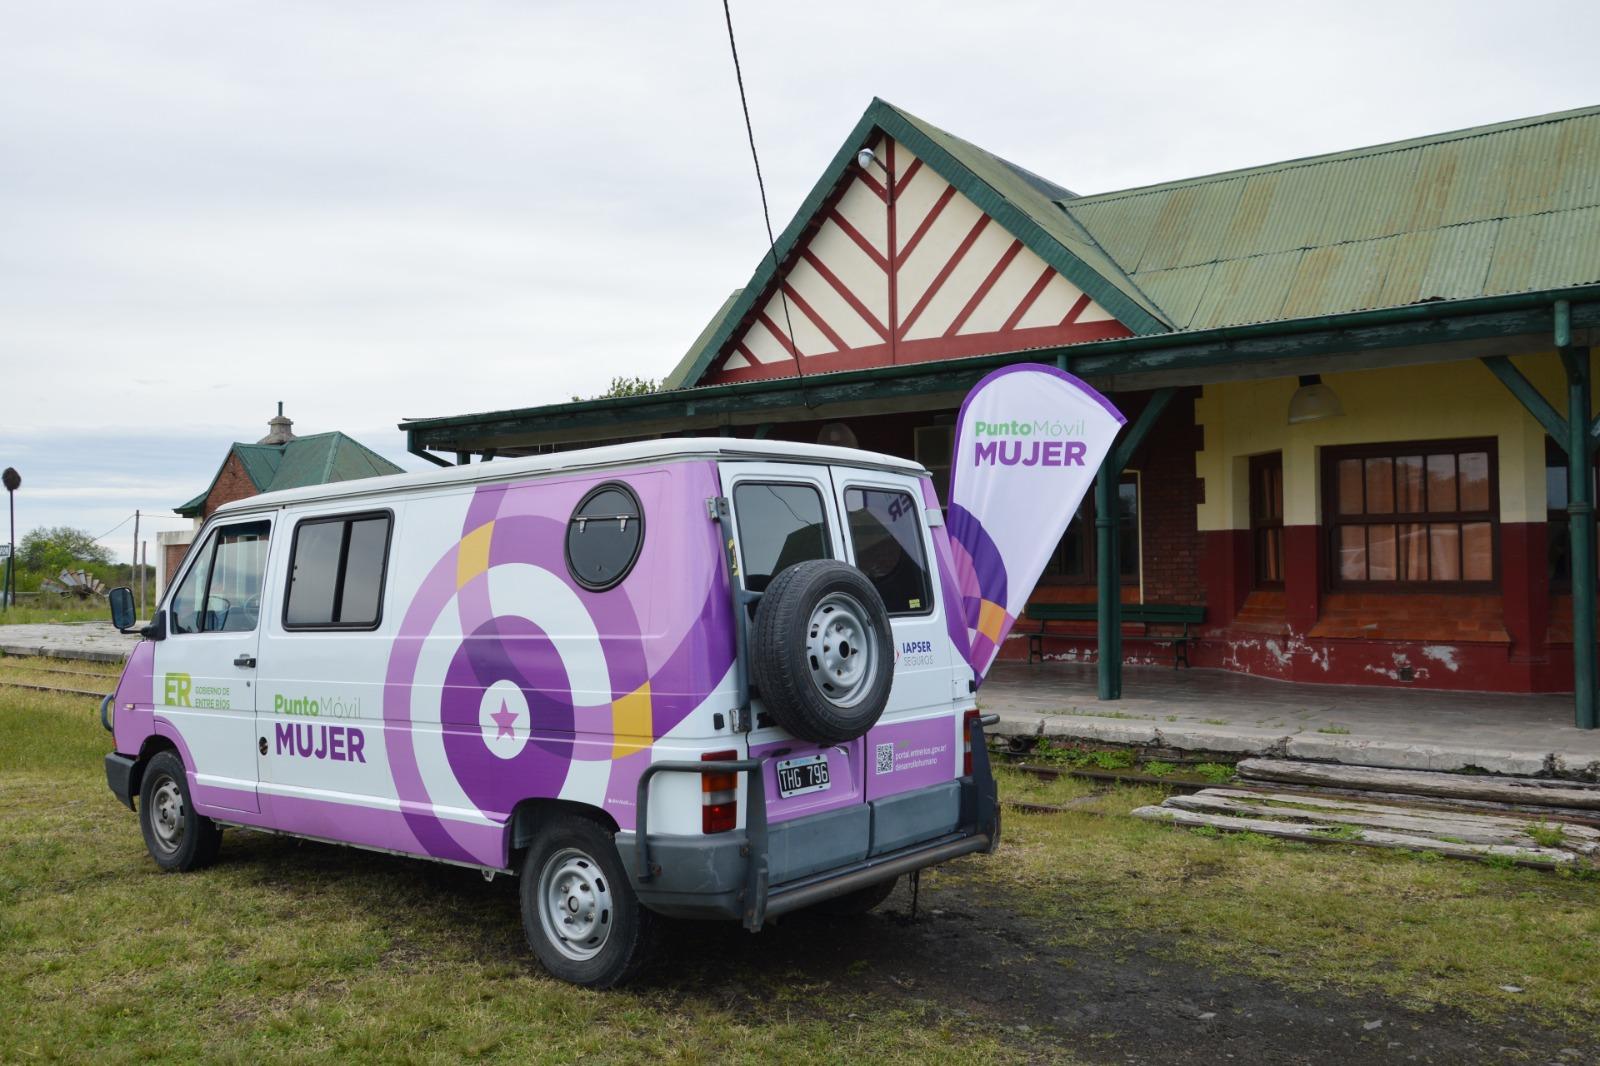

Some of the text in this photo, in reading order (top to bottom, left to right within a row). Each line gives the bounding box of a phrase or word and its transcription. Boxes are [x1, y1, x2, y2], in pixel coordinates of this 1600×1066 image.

[975, 420, 1085, 437] PuntoMóvil
[974, 440, 1087, 467] MUJER
[902, 641, 931, 653] IAPSER
[903, 655, 934, 666] SEGUROS
[164, 672, 192, 708] ER
[195, 686, 230, 696] GOBIERNO DE
[195, 698, 215, 709] ENTRE
[274, 694, 361, 719] PuntoMóvil
[275, 722, 367, 763] MUJER
[780, 763, 829, 790] THG 796
